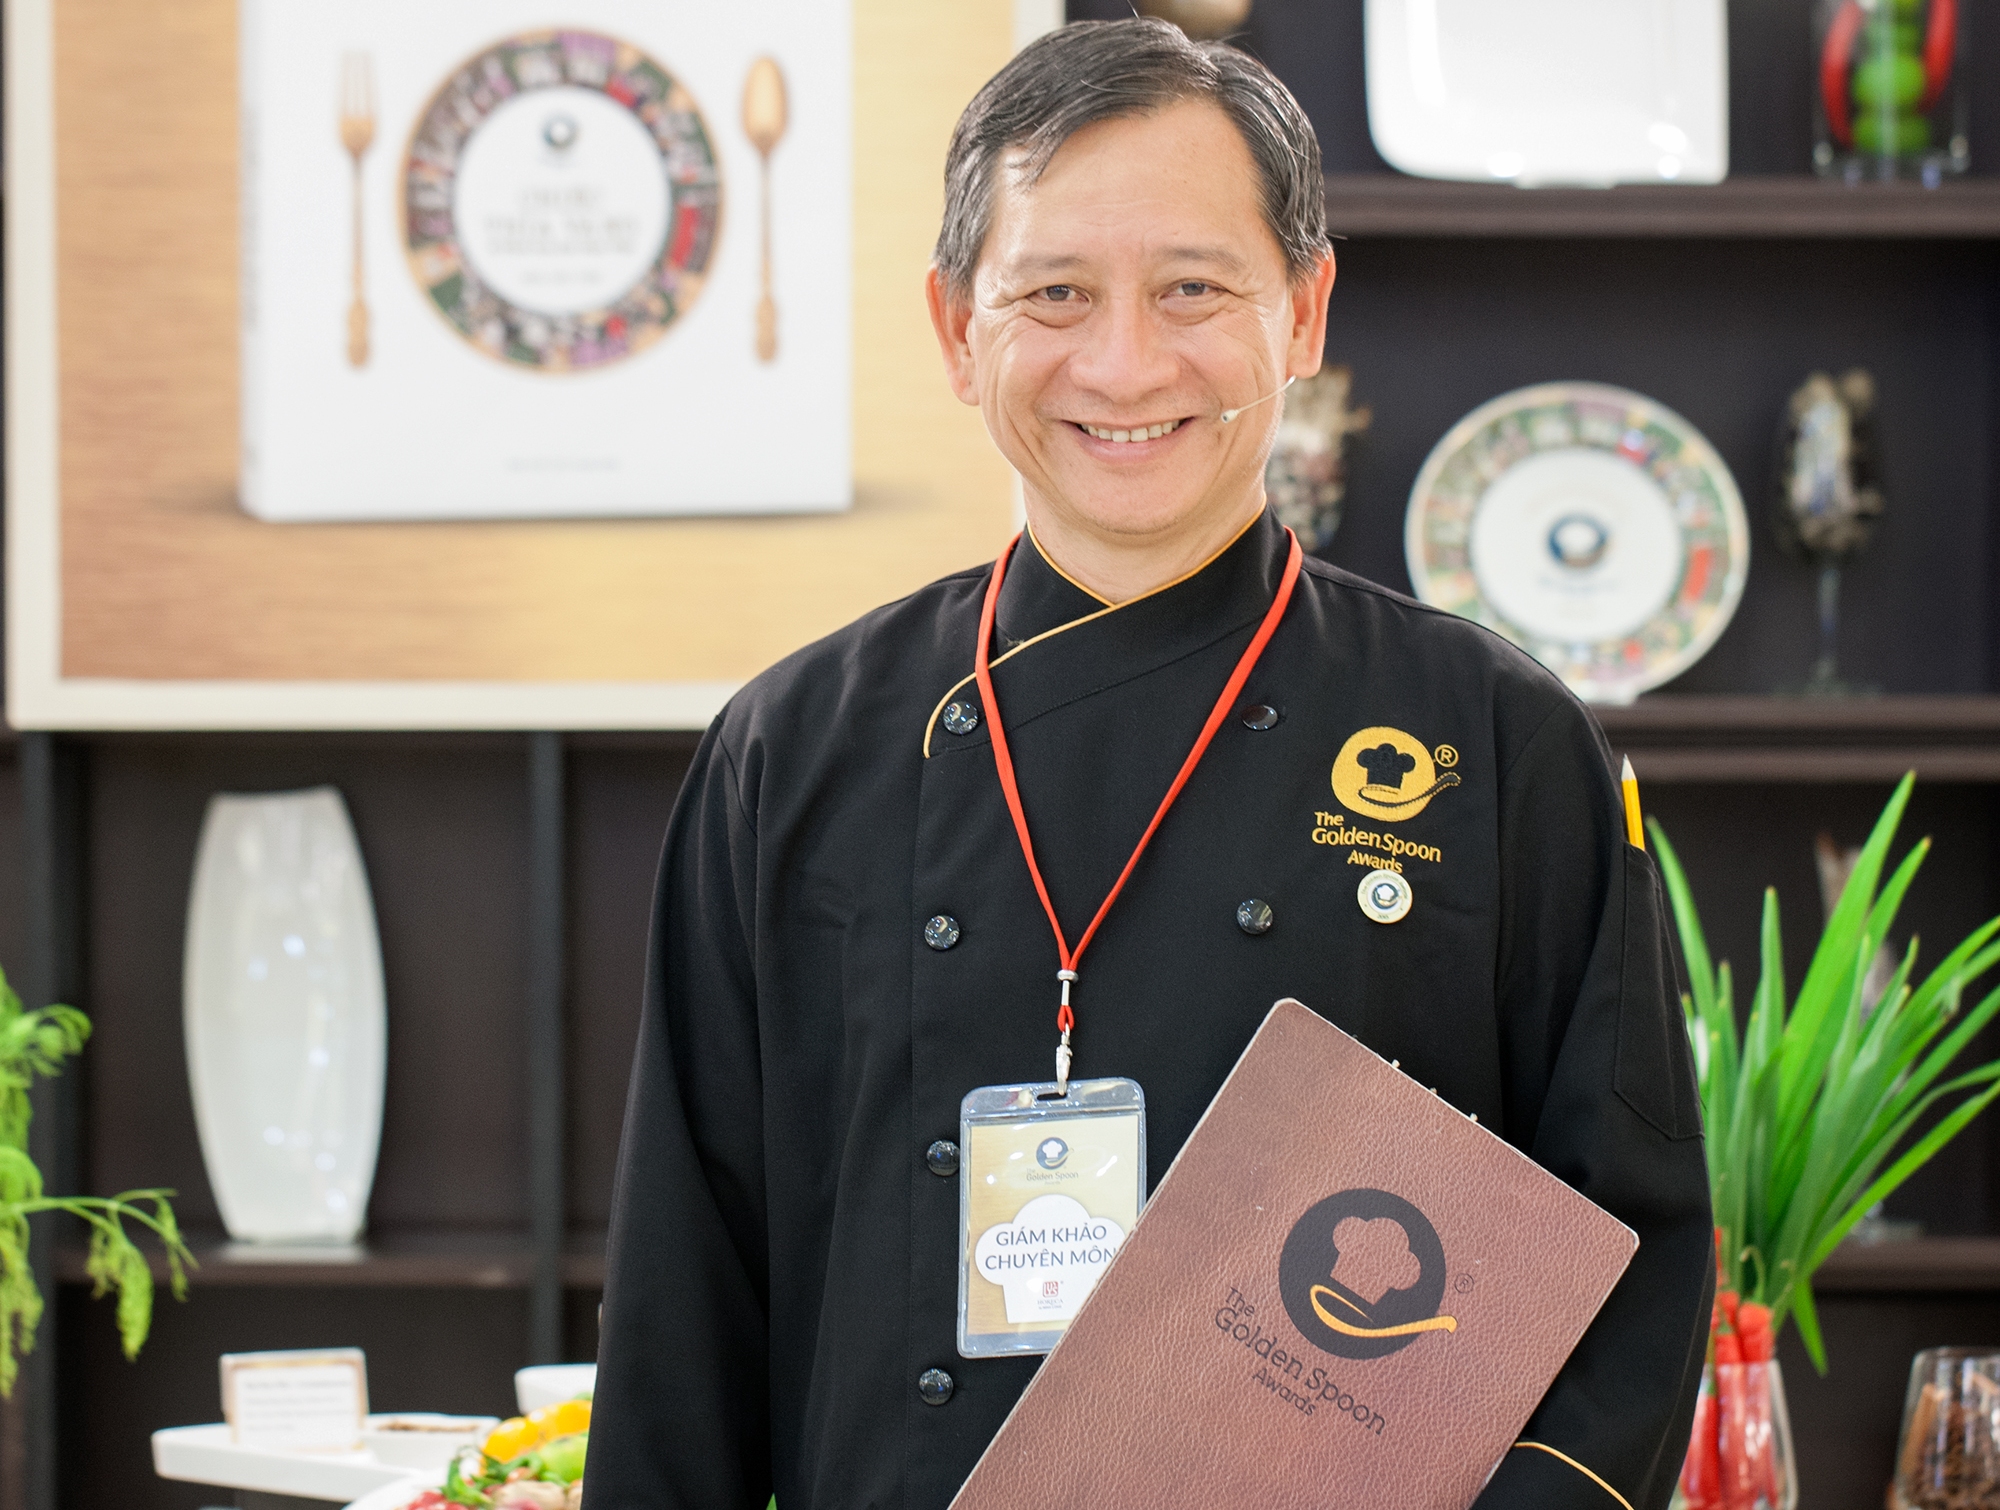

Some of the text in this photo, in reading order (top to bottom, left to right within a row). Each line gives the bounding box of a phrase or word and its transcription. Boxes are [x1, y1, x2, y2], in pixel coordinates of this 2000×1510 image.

[1314, 811, 1344, 827] The
[1347, 849, 1403, 874] Awards
[1026, 1171, 1079, 1182] Golden Spoon
[995, 1222, 1107, 1246] GIÁM KHẢO
[985, 1245, 1117, 1270] CHUYÊN MÔN
[1225, 1286, 1256, 1317] The
[1215, 1306, 1386, 1435] Golden Spoon
[1252, 1367, 1317, 1416] Awards
